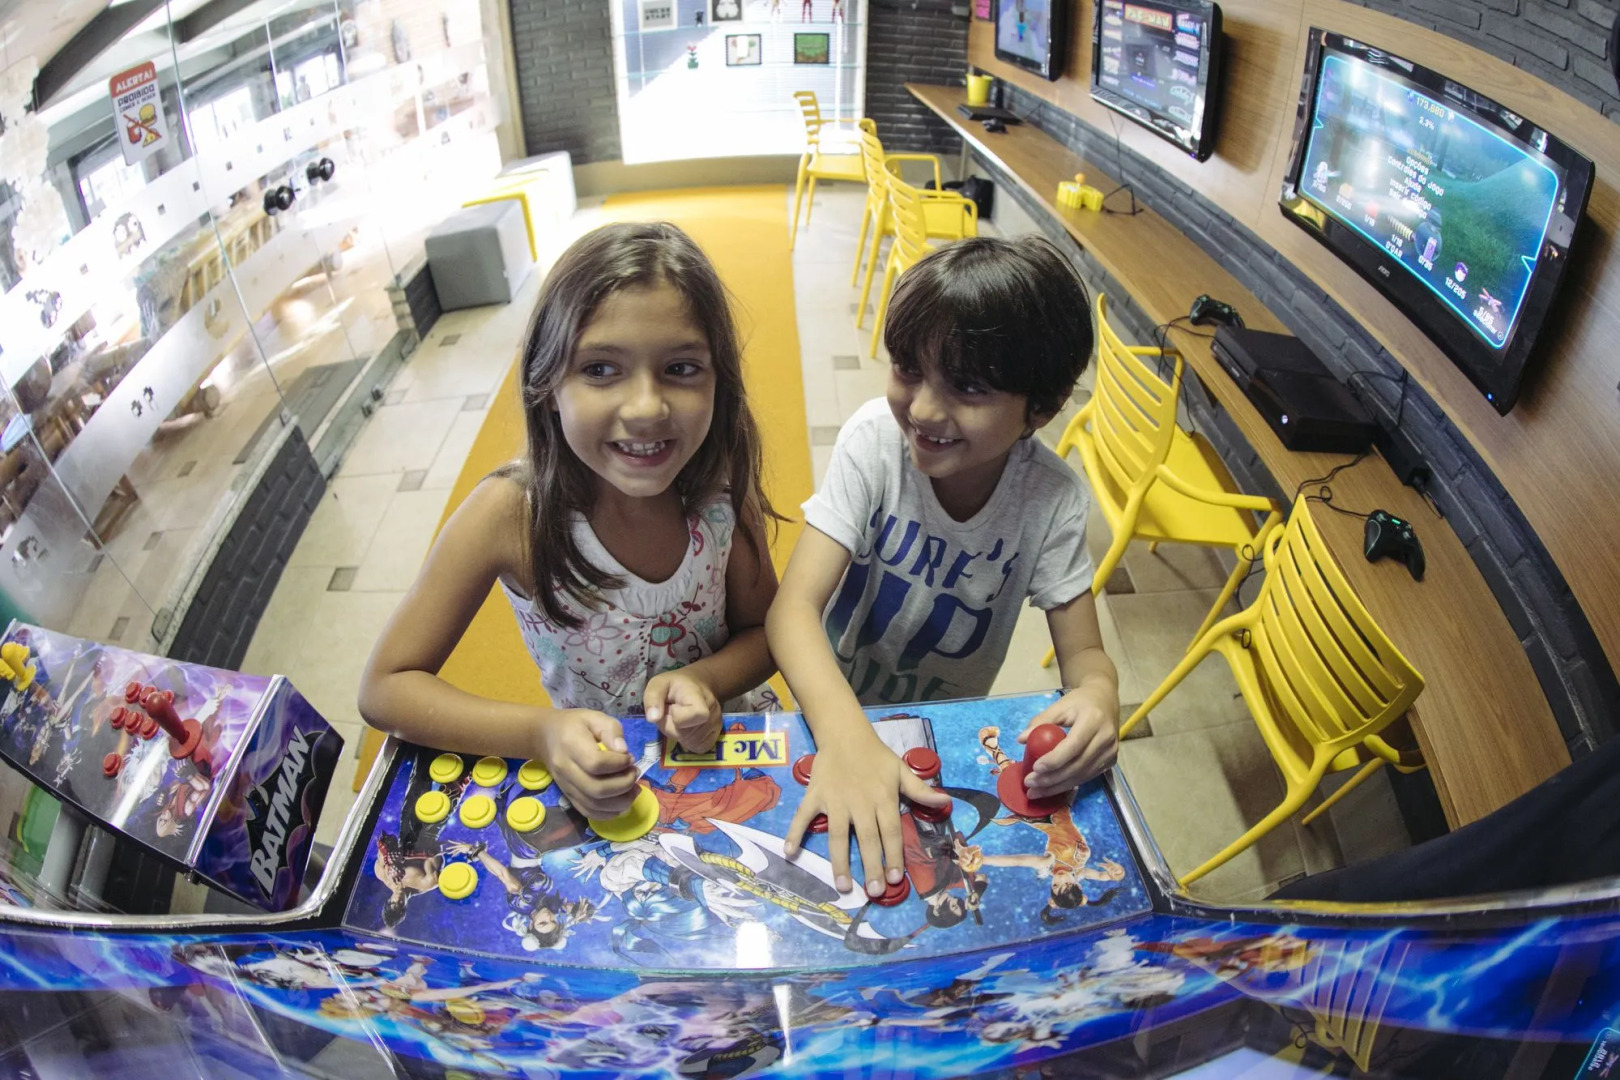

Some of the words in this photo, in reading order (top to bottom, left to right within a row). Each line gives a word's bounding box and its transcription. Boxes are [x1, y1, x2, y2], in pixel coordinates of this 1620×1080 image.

[116, 69, 153, 94] ALERTA!
[118, 83, 155, 107] PROIBIDO
[1387, 155, 1417, 179] Controles
[1418, 174, 1427, 185] do
[1427, 181, 1445, 197] Jogo
[1406, 156, 1429, 176] Opções
[1404, 177, 1422, 193] Ajuda
[1445, 276, 1467, 299] 12/205
[734, 738, 782, 760] Mc
[250, 725, 310, 896] BATMAN
